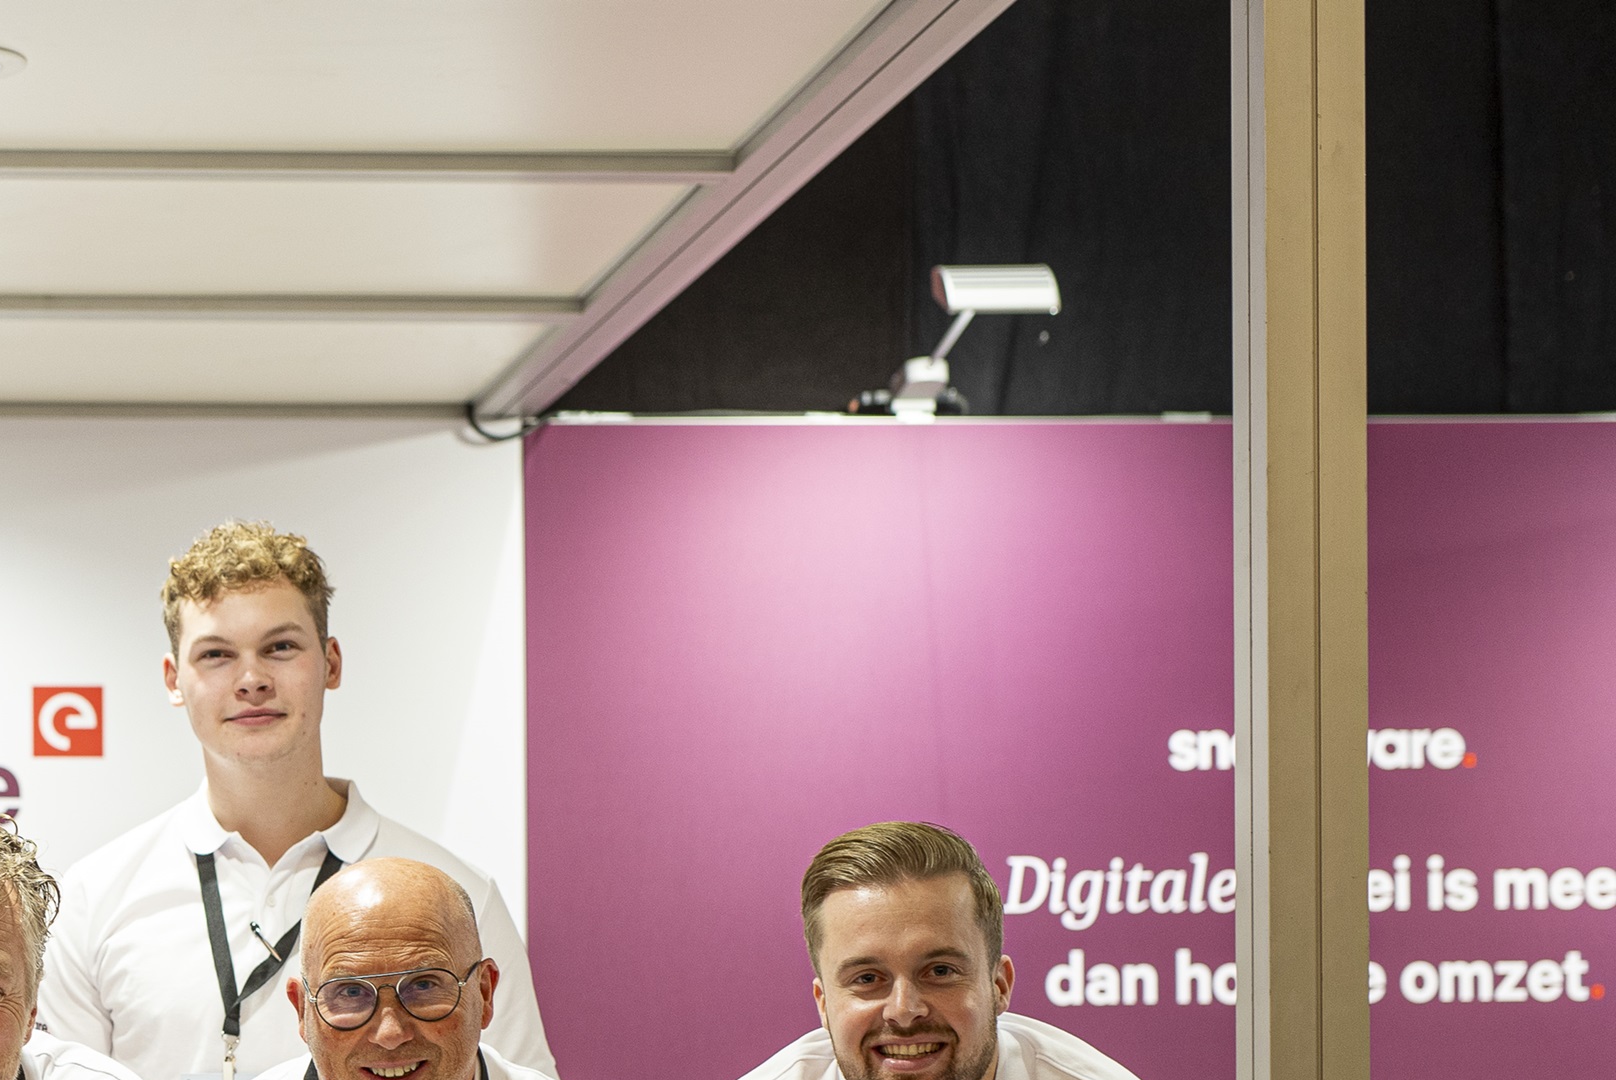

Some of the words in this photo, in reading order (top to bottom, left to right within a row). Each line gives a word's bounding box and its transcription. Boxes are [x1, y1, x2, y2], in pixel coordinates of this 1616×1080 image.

[1168, 728, 1478, 772] snare.
[1003, 852, 1237, 931] Digitale
[1426, 854, 1479, 912] is
[1045, 948, 1159, 1006] dan
[1399, 950, 1606, 1004] omzet.
